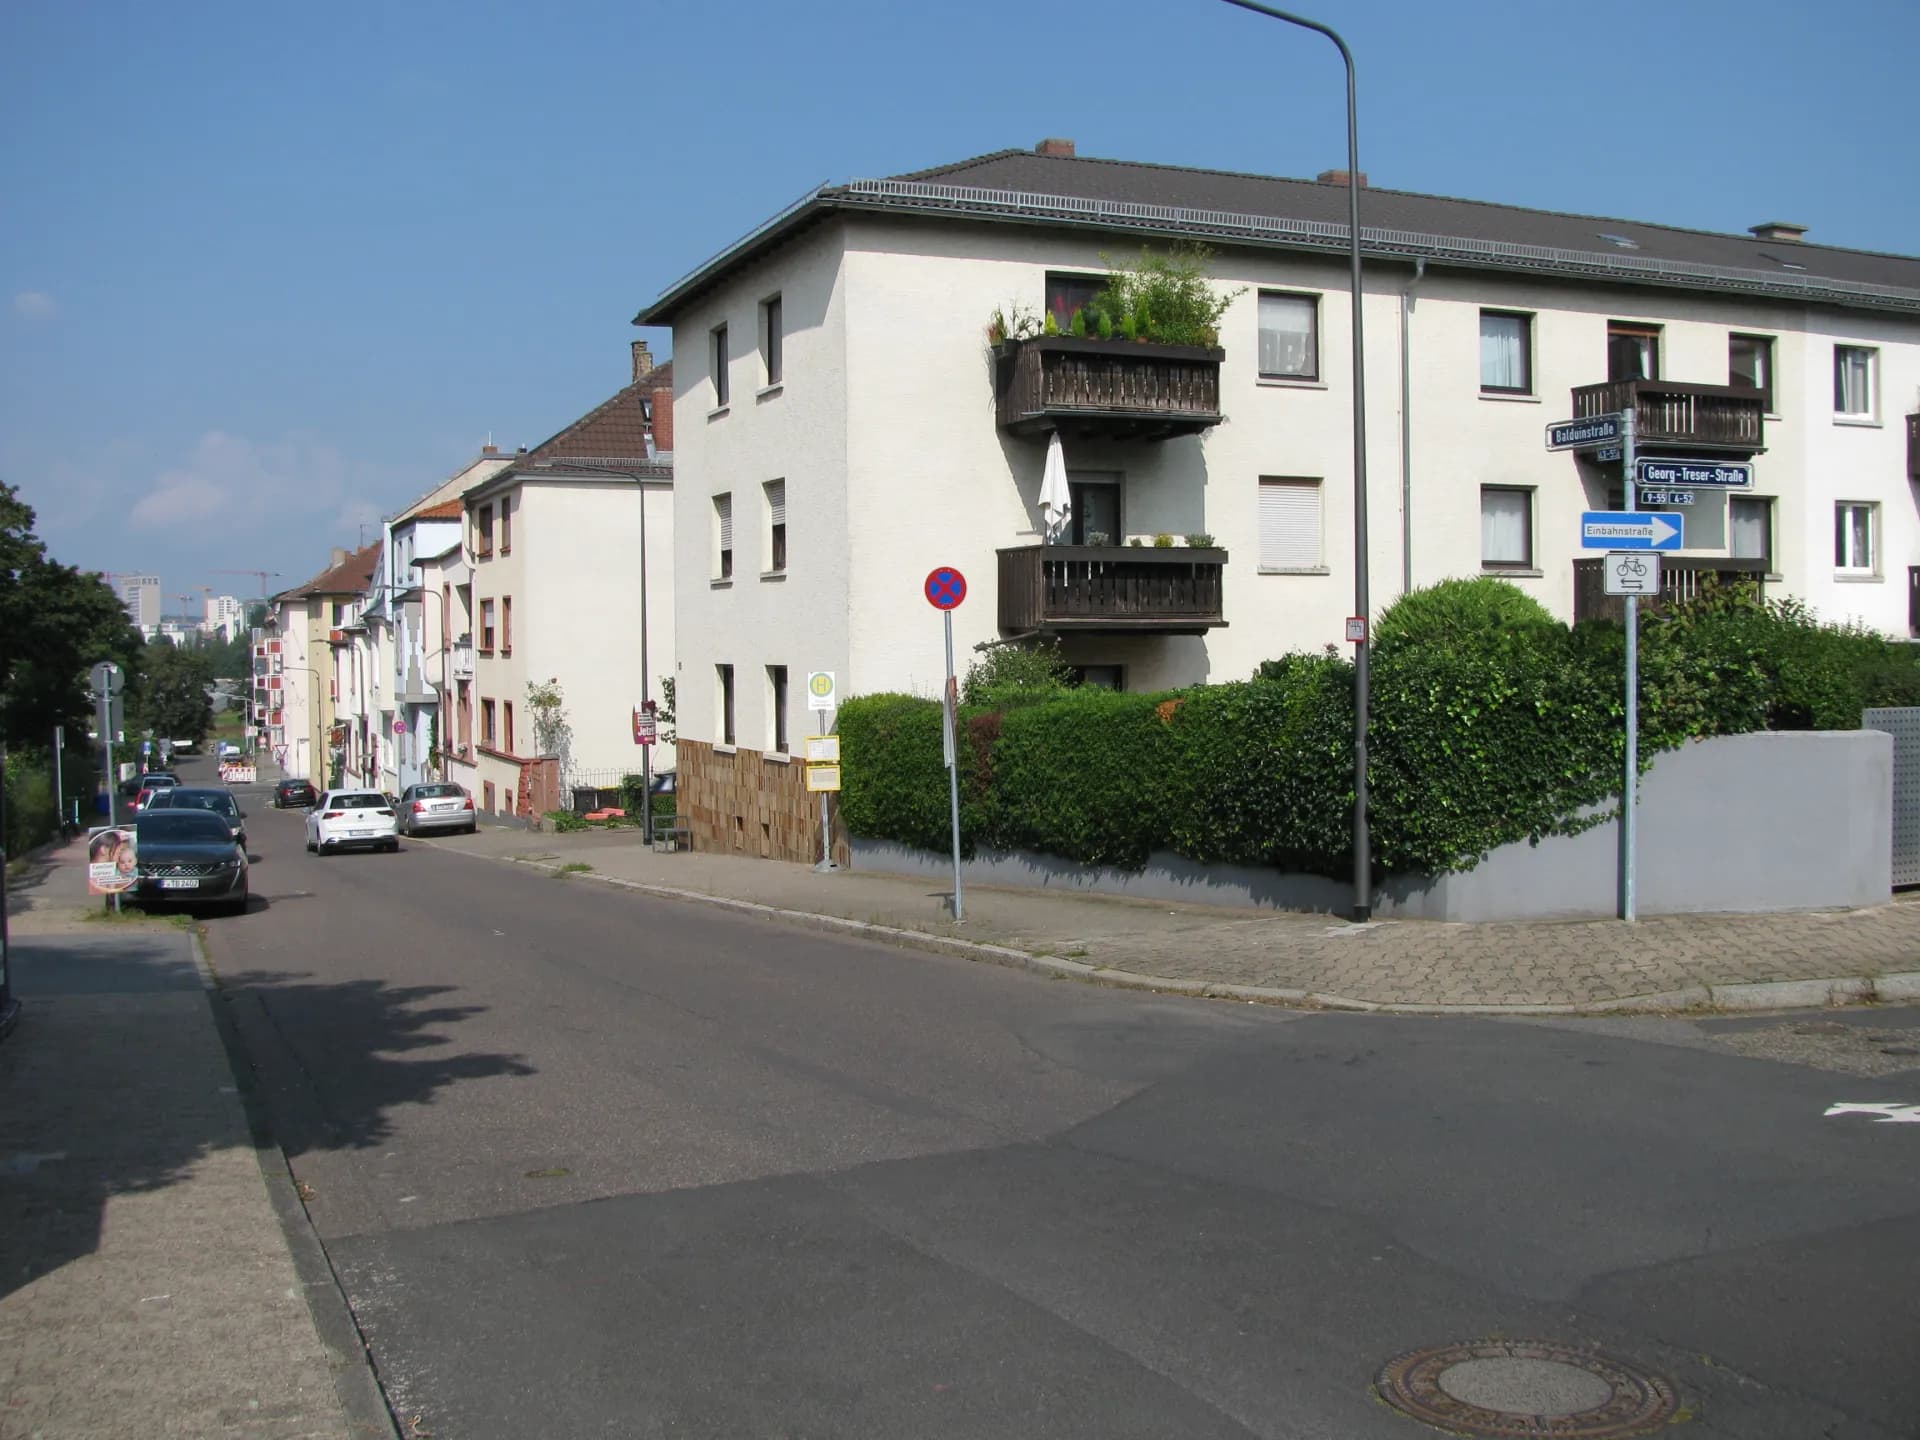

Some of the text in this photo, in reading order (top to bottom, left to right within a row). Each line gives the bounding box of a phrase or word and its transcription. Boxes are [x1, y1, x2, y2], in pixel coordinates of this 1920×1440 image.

[1555, 422, 1614, 443] Balduinstraße
[1648, 465, 1744, 483] Georg-Treser-Straße
[1647, 493, 1666, 504] 9-55
[1674, 494, 1693, 504] 4-52
[1586, 526, 1654, 537] Einbahnstraße
